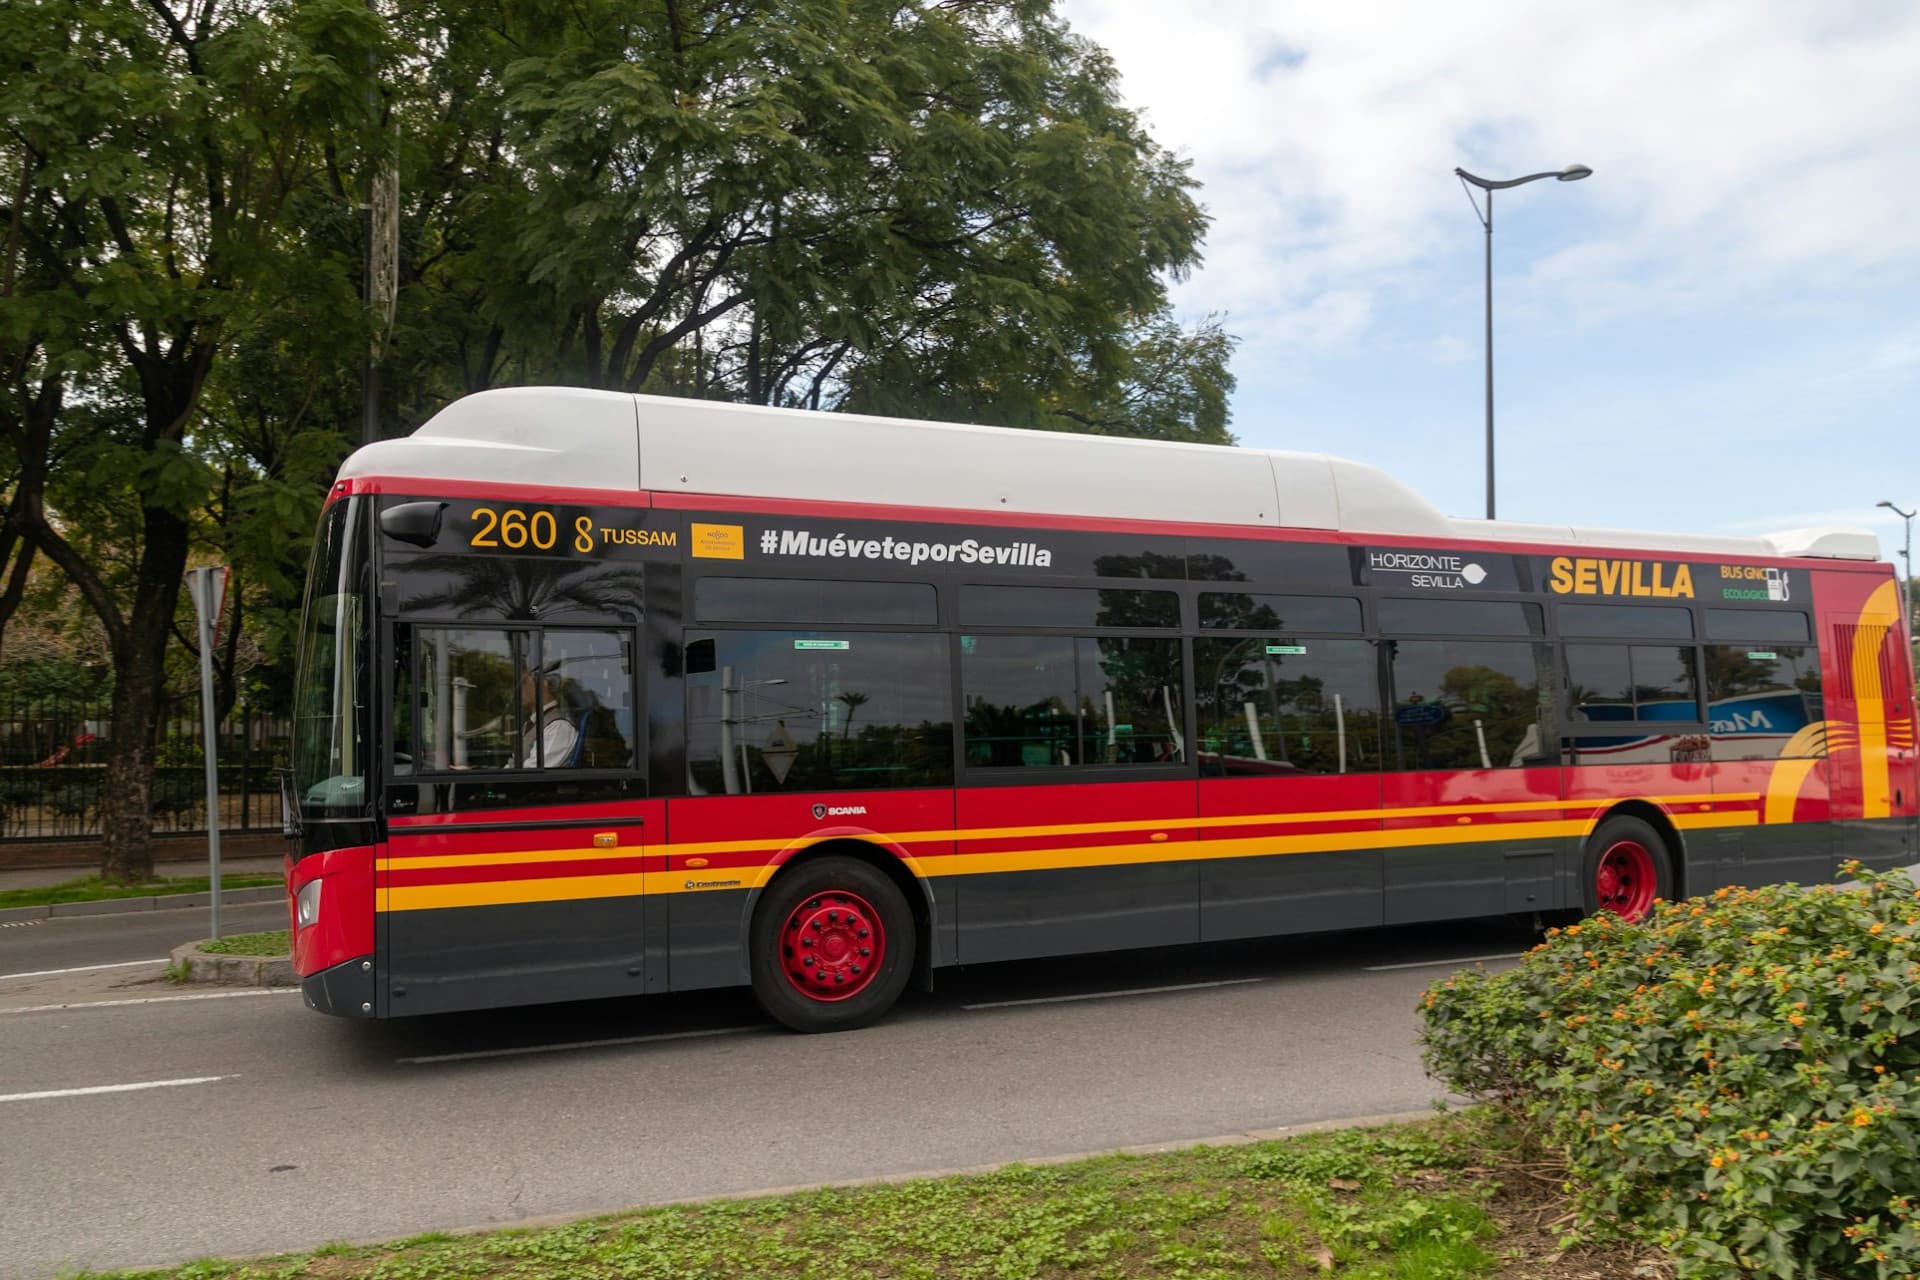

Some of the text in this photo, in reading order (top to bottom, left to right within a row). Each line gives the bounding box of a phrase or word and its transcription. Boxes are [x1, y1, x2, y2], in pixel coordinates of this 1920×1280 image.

[470, 507, 557, 550] 260
[600, 528, 677, 547] TUSSAM
[760, 530, 1052, 567] #MuéveteporSevilla
[1370, 553, 1462, 571] HORIZONTE
[1411, 574, 1464, 588] SEVILLA
[1550, 557, 1695, 599] SEVILLA
[1720, 565, 1767, 580] BUS GNC
[828, 806, 867, 816] SCANIA
